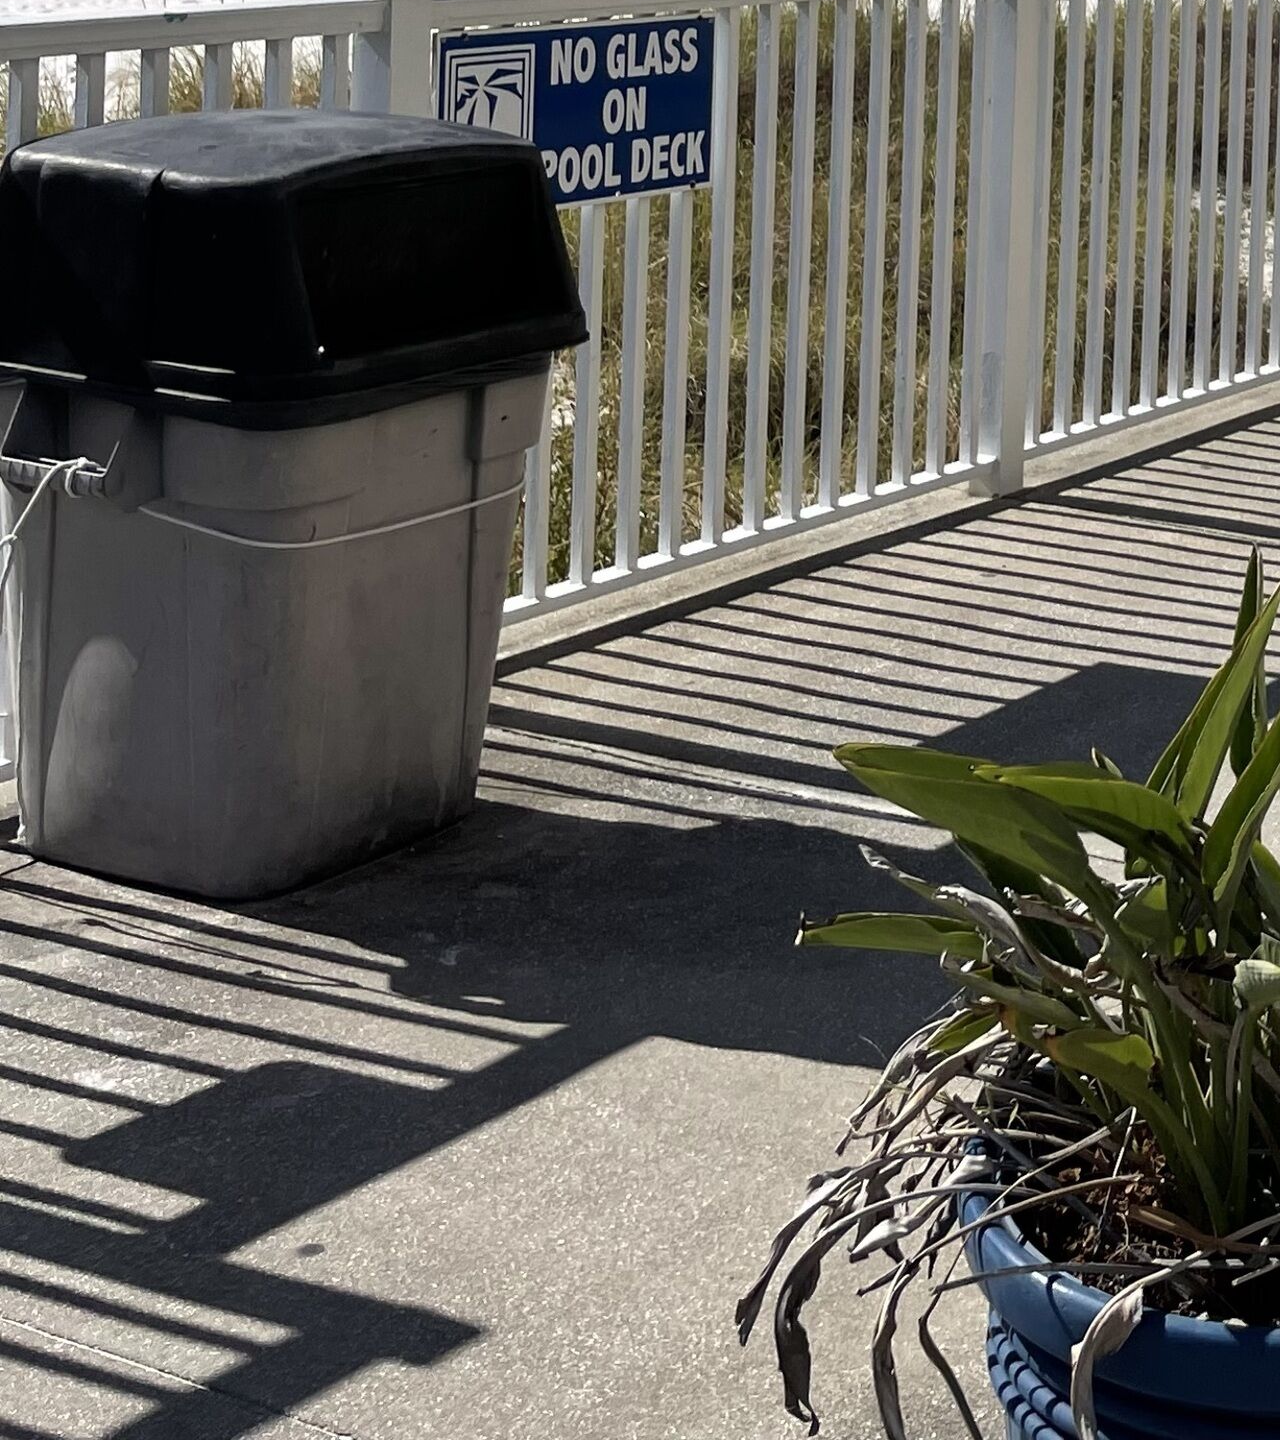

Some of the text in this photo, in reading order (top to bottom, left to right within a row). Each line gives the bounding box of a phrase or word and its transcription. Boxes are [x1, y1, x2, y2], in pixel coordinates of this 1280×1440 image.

[550, 27, 699, 86] NO GLASS
[602, 86, 647, 135] ON
[540, 130, 706, 194] POOL DECK
